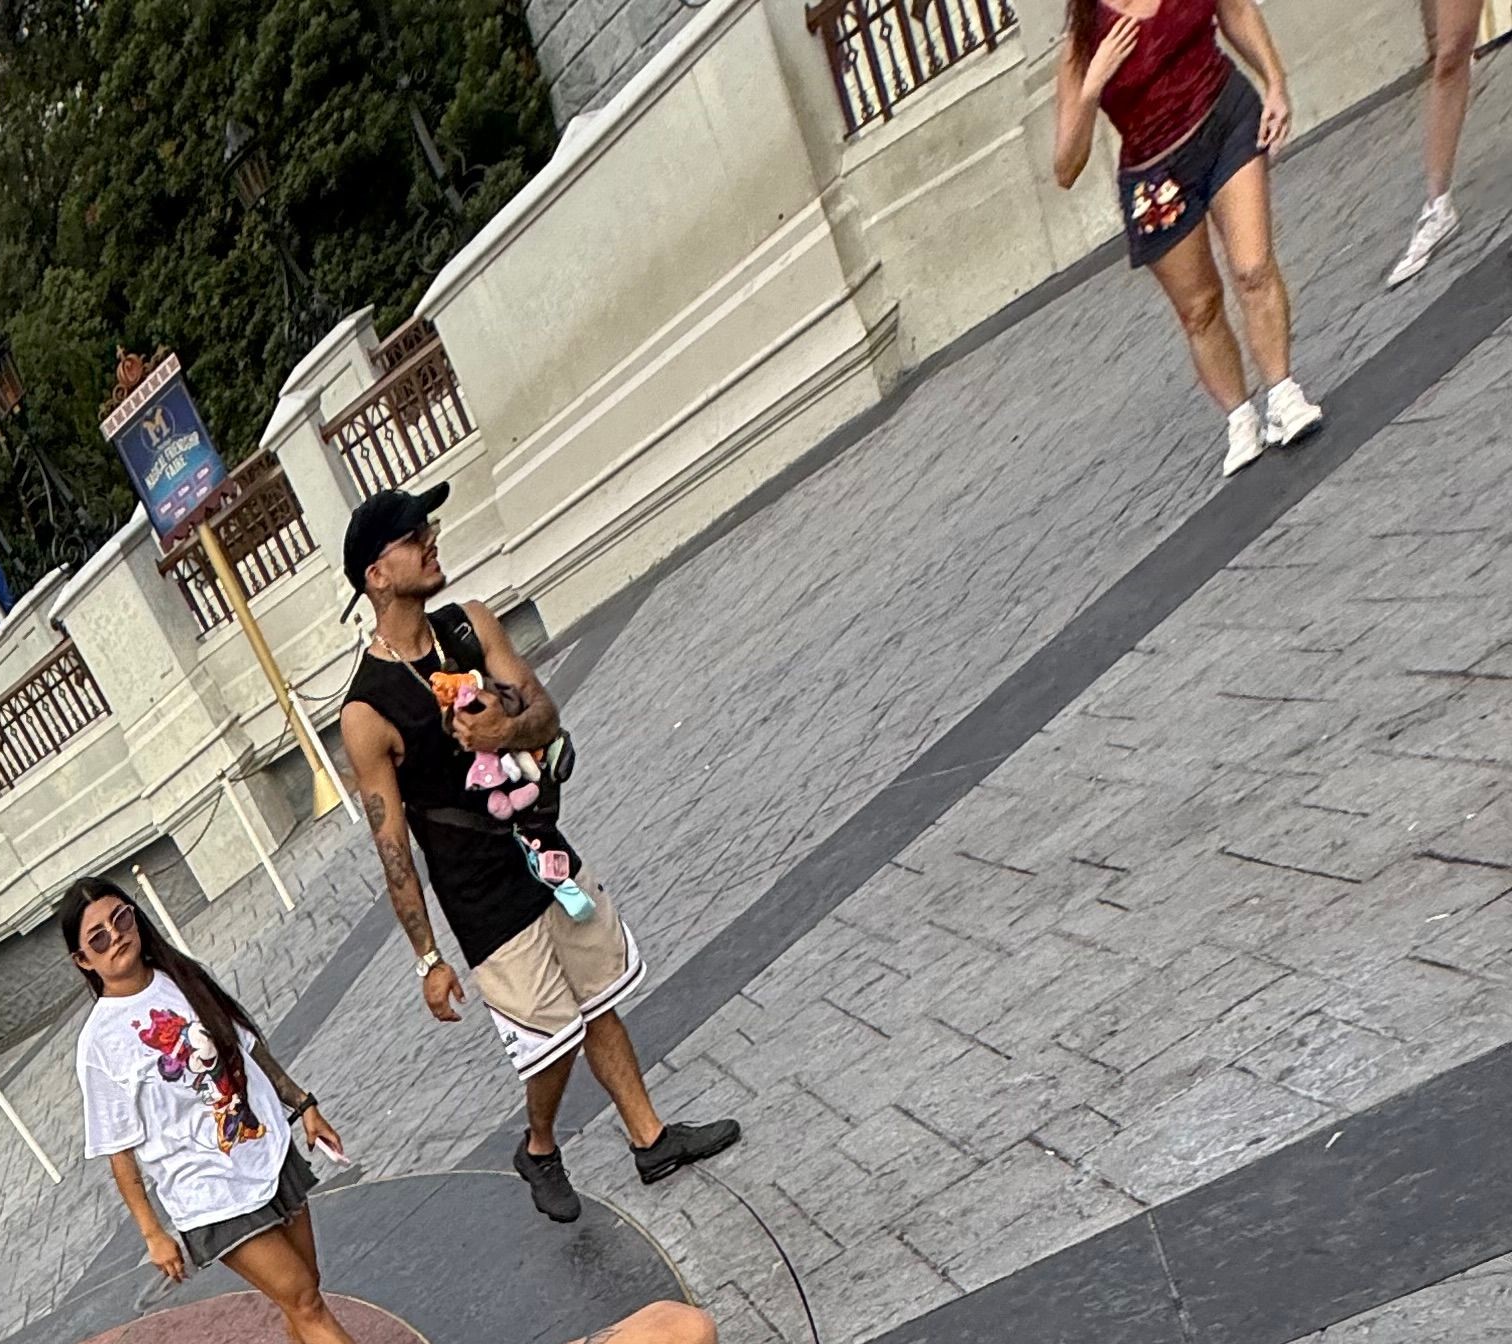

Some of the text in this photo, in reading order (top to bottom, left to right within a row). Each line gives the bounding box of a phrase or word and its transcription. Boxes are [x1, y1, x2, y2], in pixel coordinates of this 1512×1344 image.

[144, 453, 168, 491] MAGICAL
[164, 431, 201, 461] FRIENDSHIP
[164, 454, 188, 481] FAIRE
